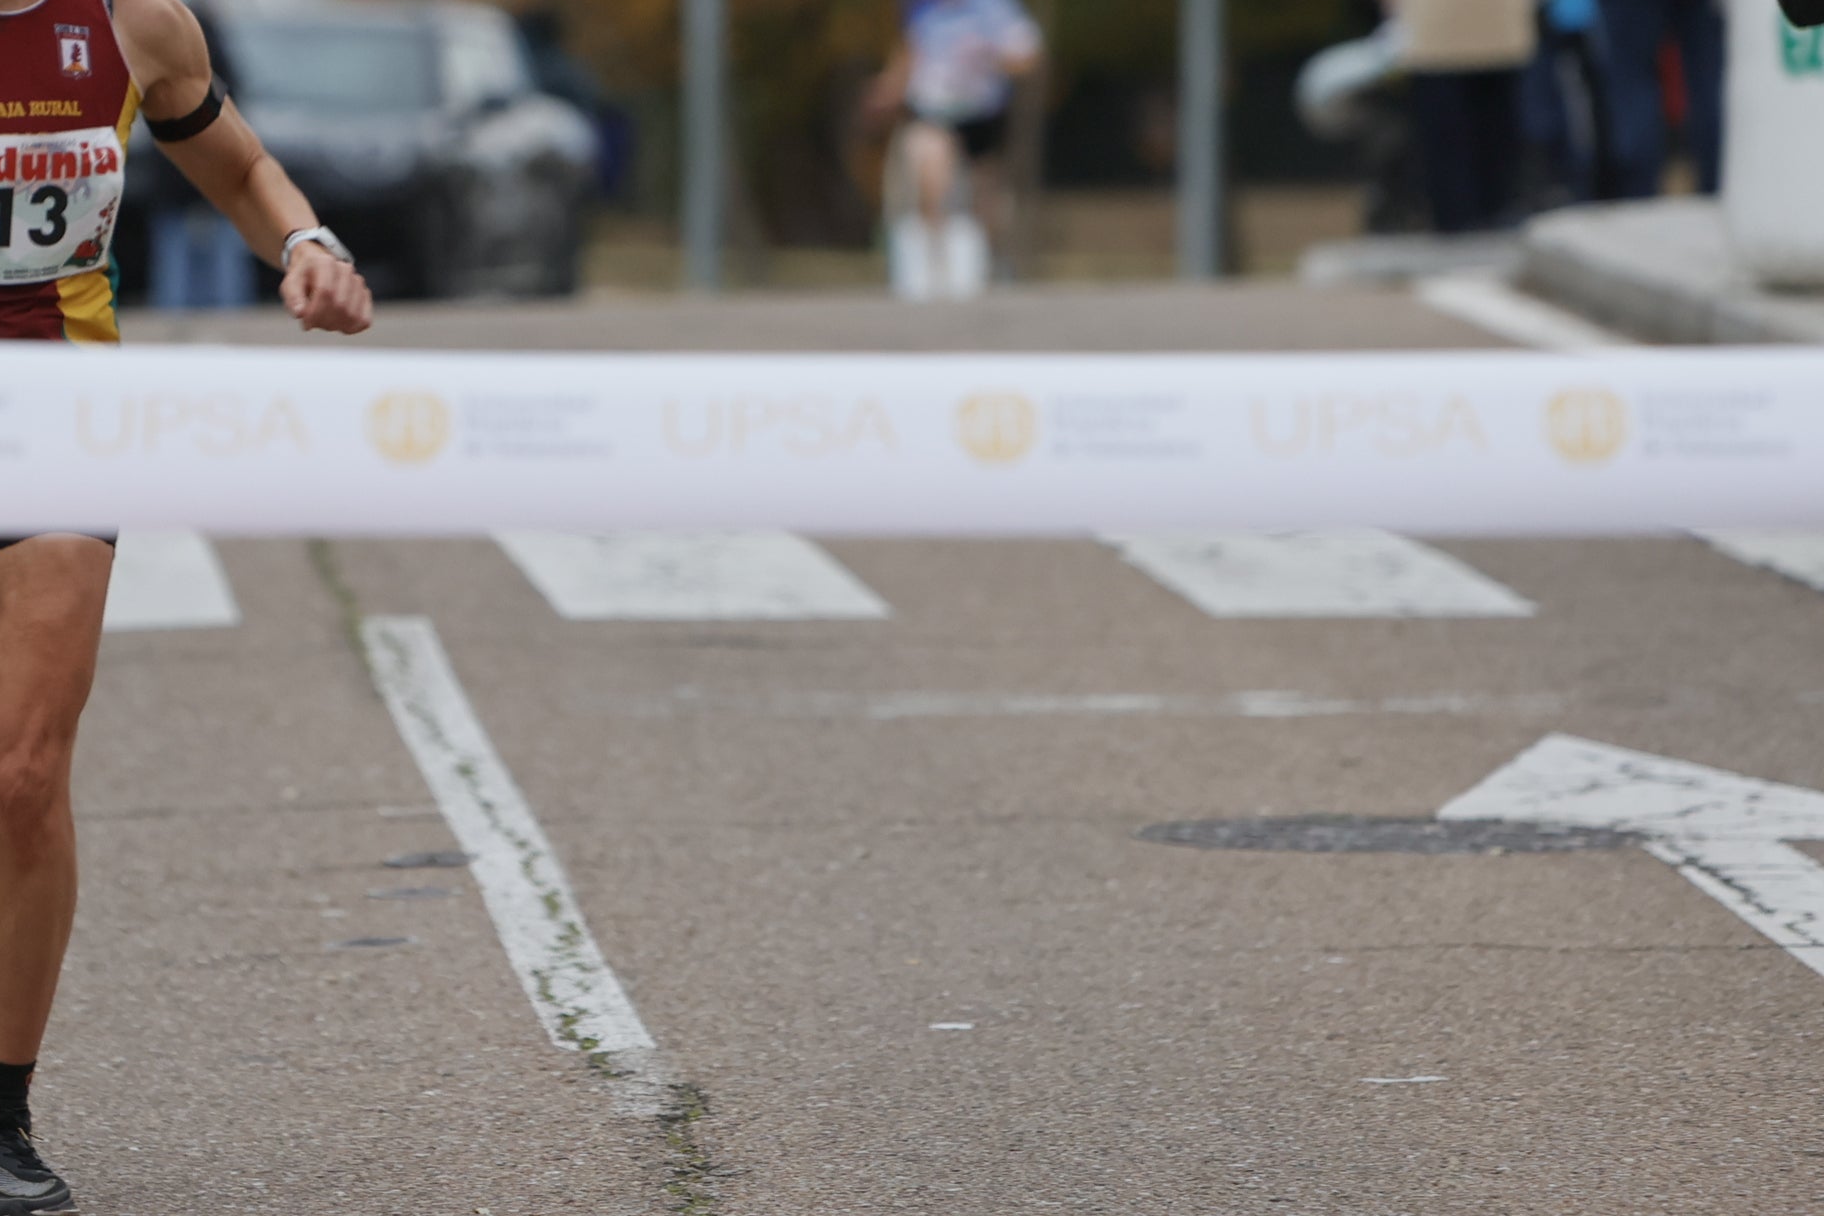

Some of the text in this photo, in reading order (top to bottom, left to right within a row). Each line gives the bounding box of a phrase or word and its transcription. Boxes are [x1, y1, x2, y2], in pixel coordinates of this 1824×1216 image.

[29, 99, 82, 117] RURAL
[74, 392, 313, 459] UPSA
[660, 394, 899, 459] UPSA
[1249, 393, 1490, 459] UPSA
